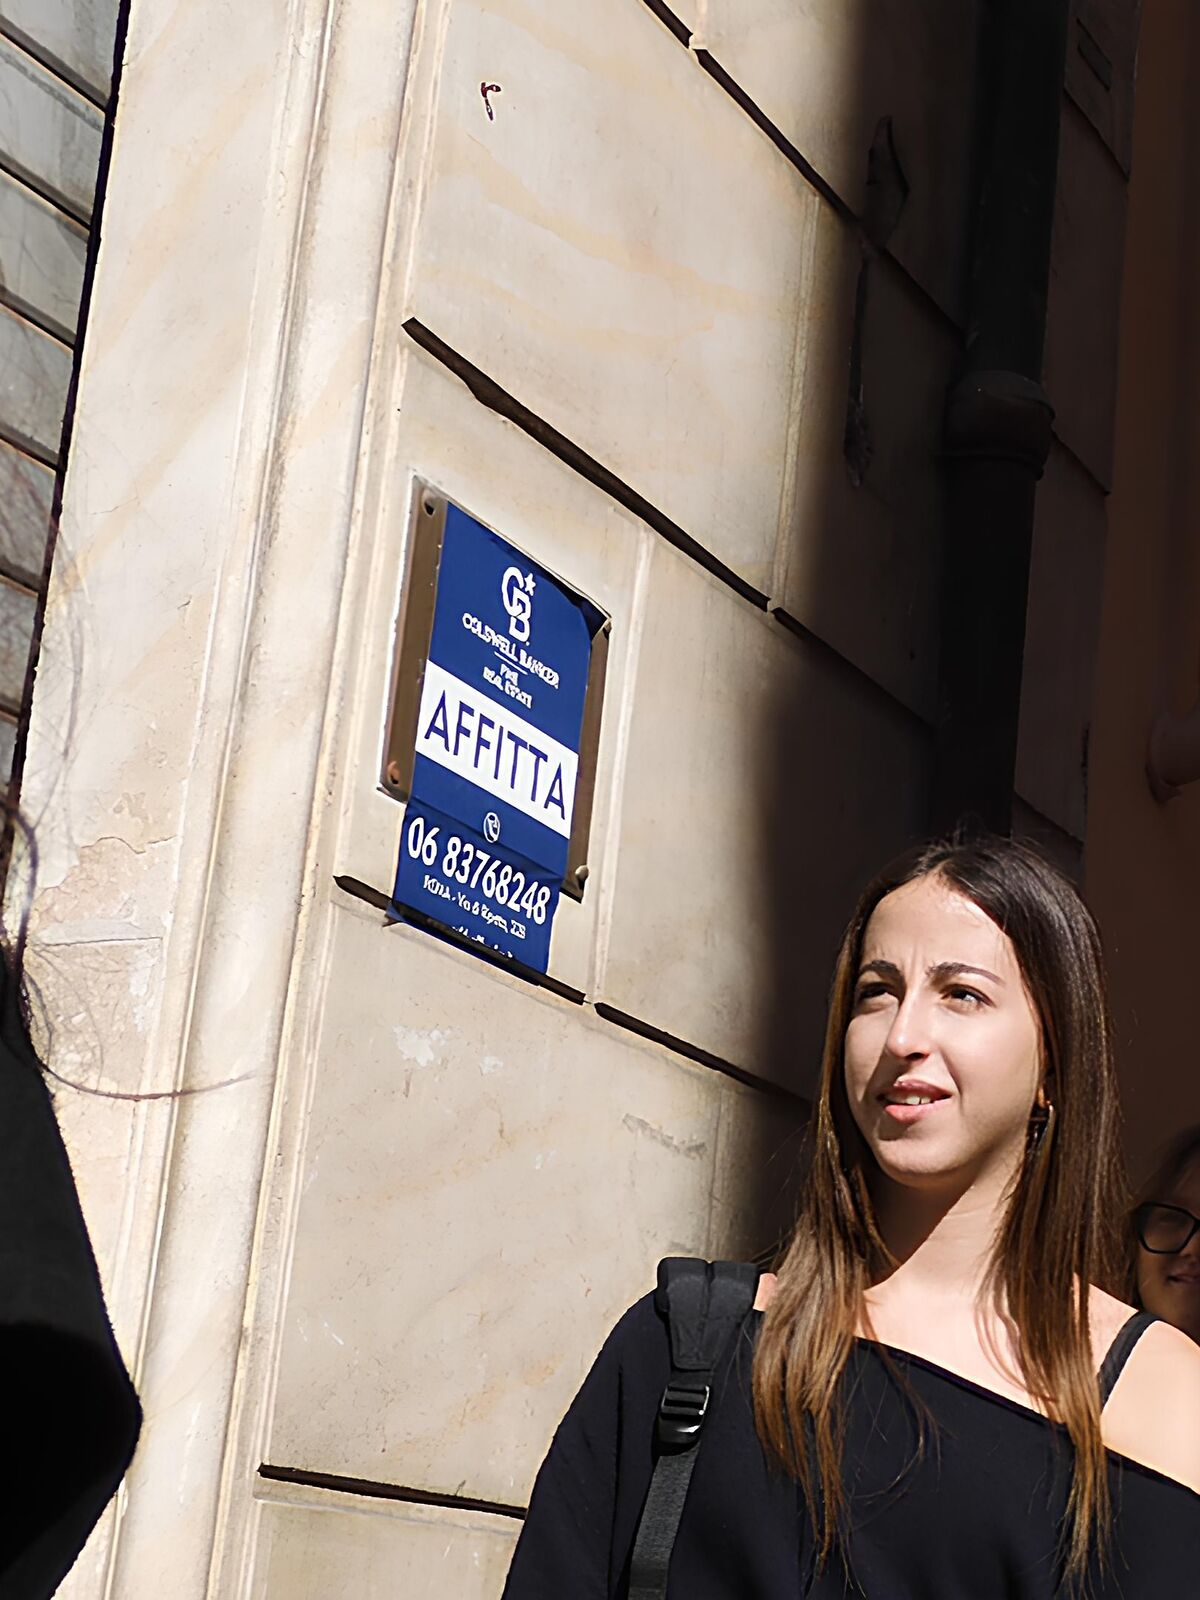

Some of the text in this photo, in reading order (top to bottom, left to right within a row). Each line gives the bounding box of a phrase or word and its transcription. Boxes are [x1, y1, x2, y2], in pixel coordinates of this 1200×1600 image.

[424, 689, 566, 820] AFFITTA
[408, 817, 440, 866] 06
[442, 836, 551, 925] 83768248
